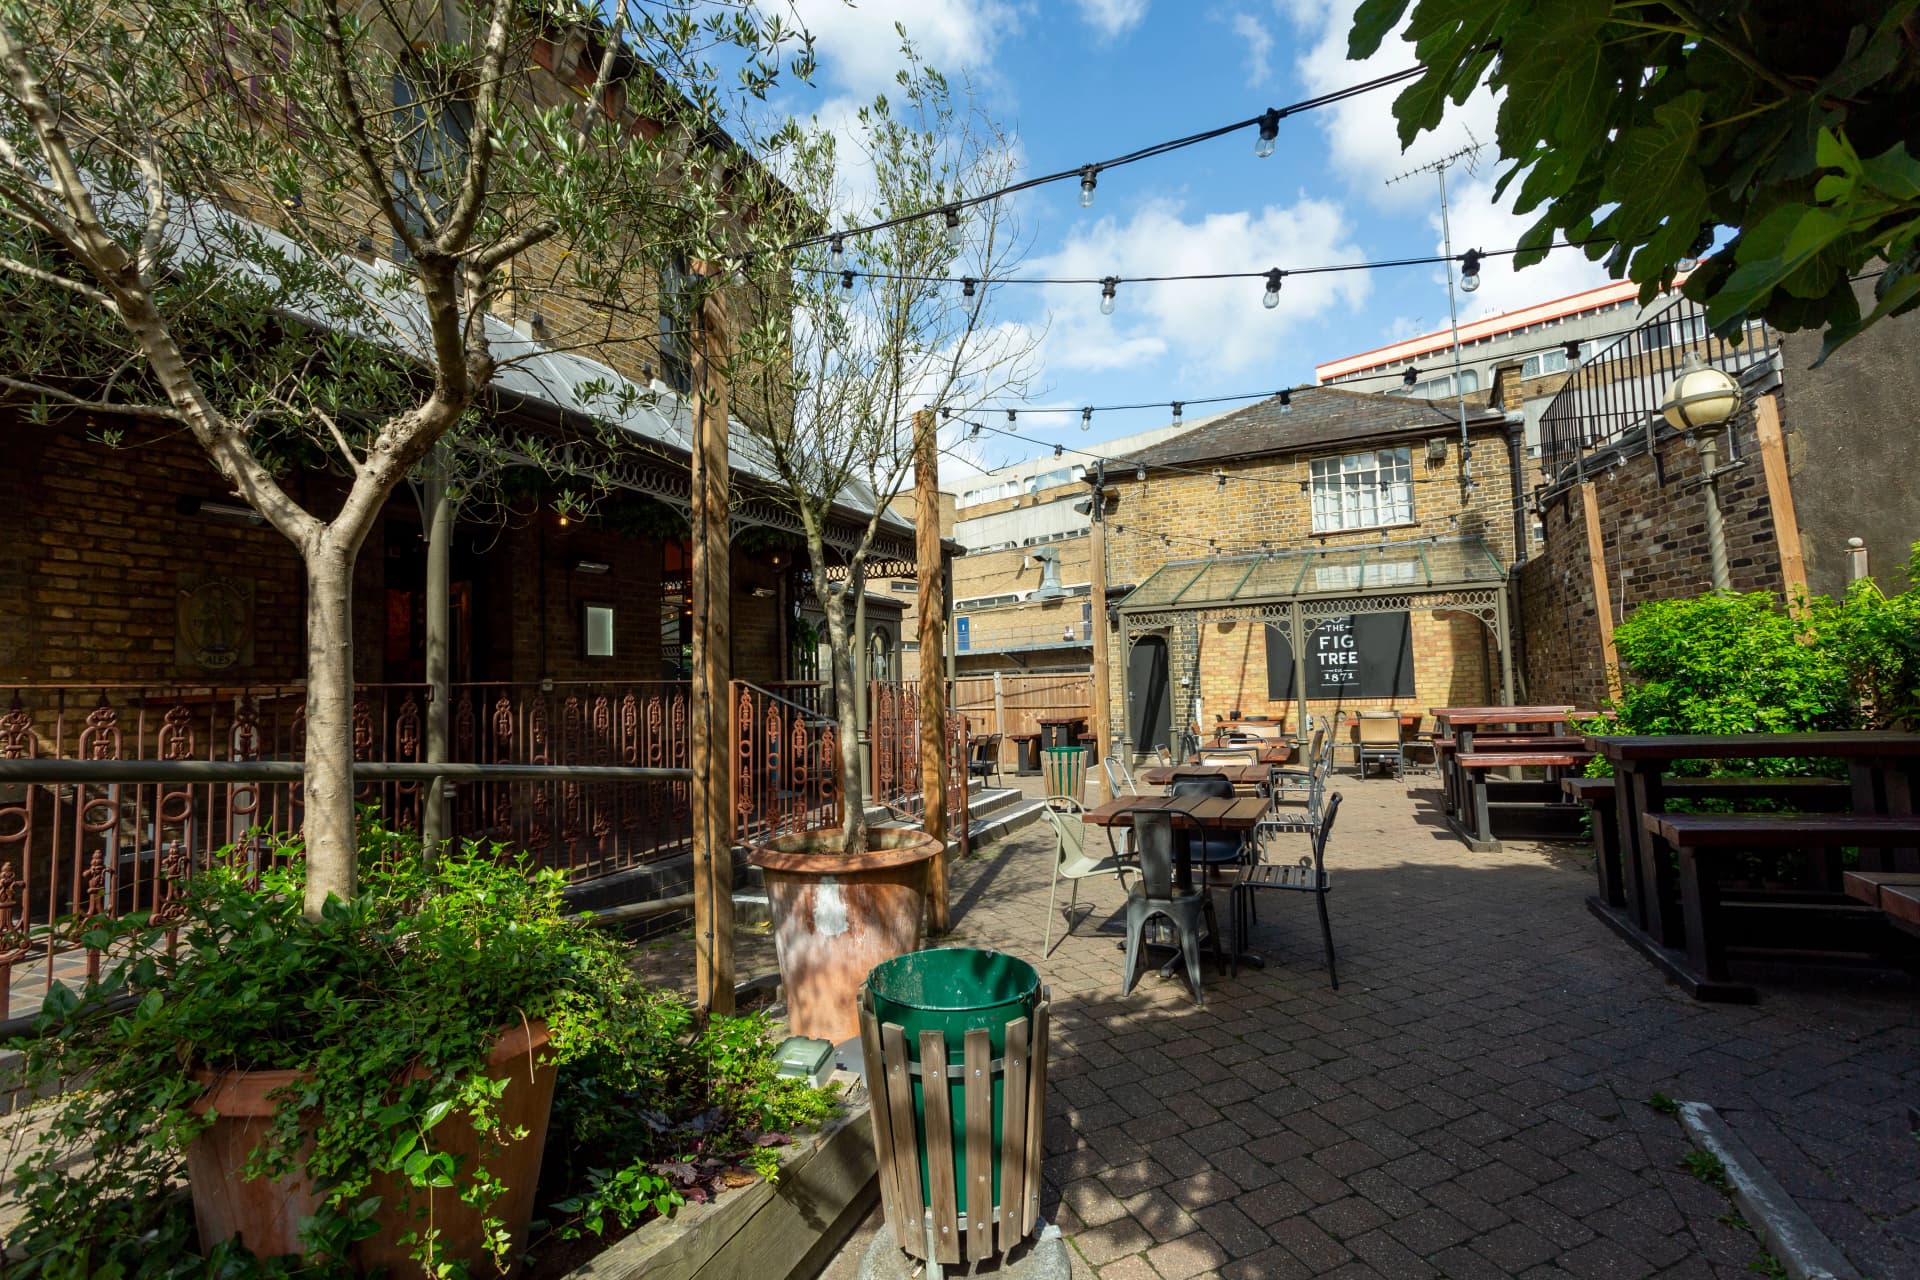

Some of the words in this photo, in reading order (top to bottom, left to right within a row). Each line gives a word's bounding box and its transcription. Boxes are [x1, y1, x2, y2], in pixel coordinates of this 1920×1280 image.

[1325, 624, 1345, 632] THE
[1319, 634, 1354, 650] FIG
[205, 655, 230, 665] ALES
[1317, 651, 1359, 666] TREE
[1323, 672, 1354, 682] 1871
